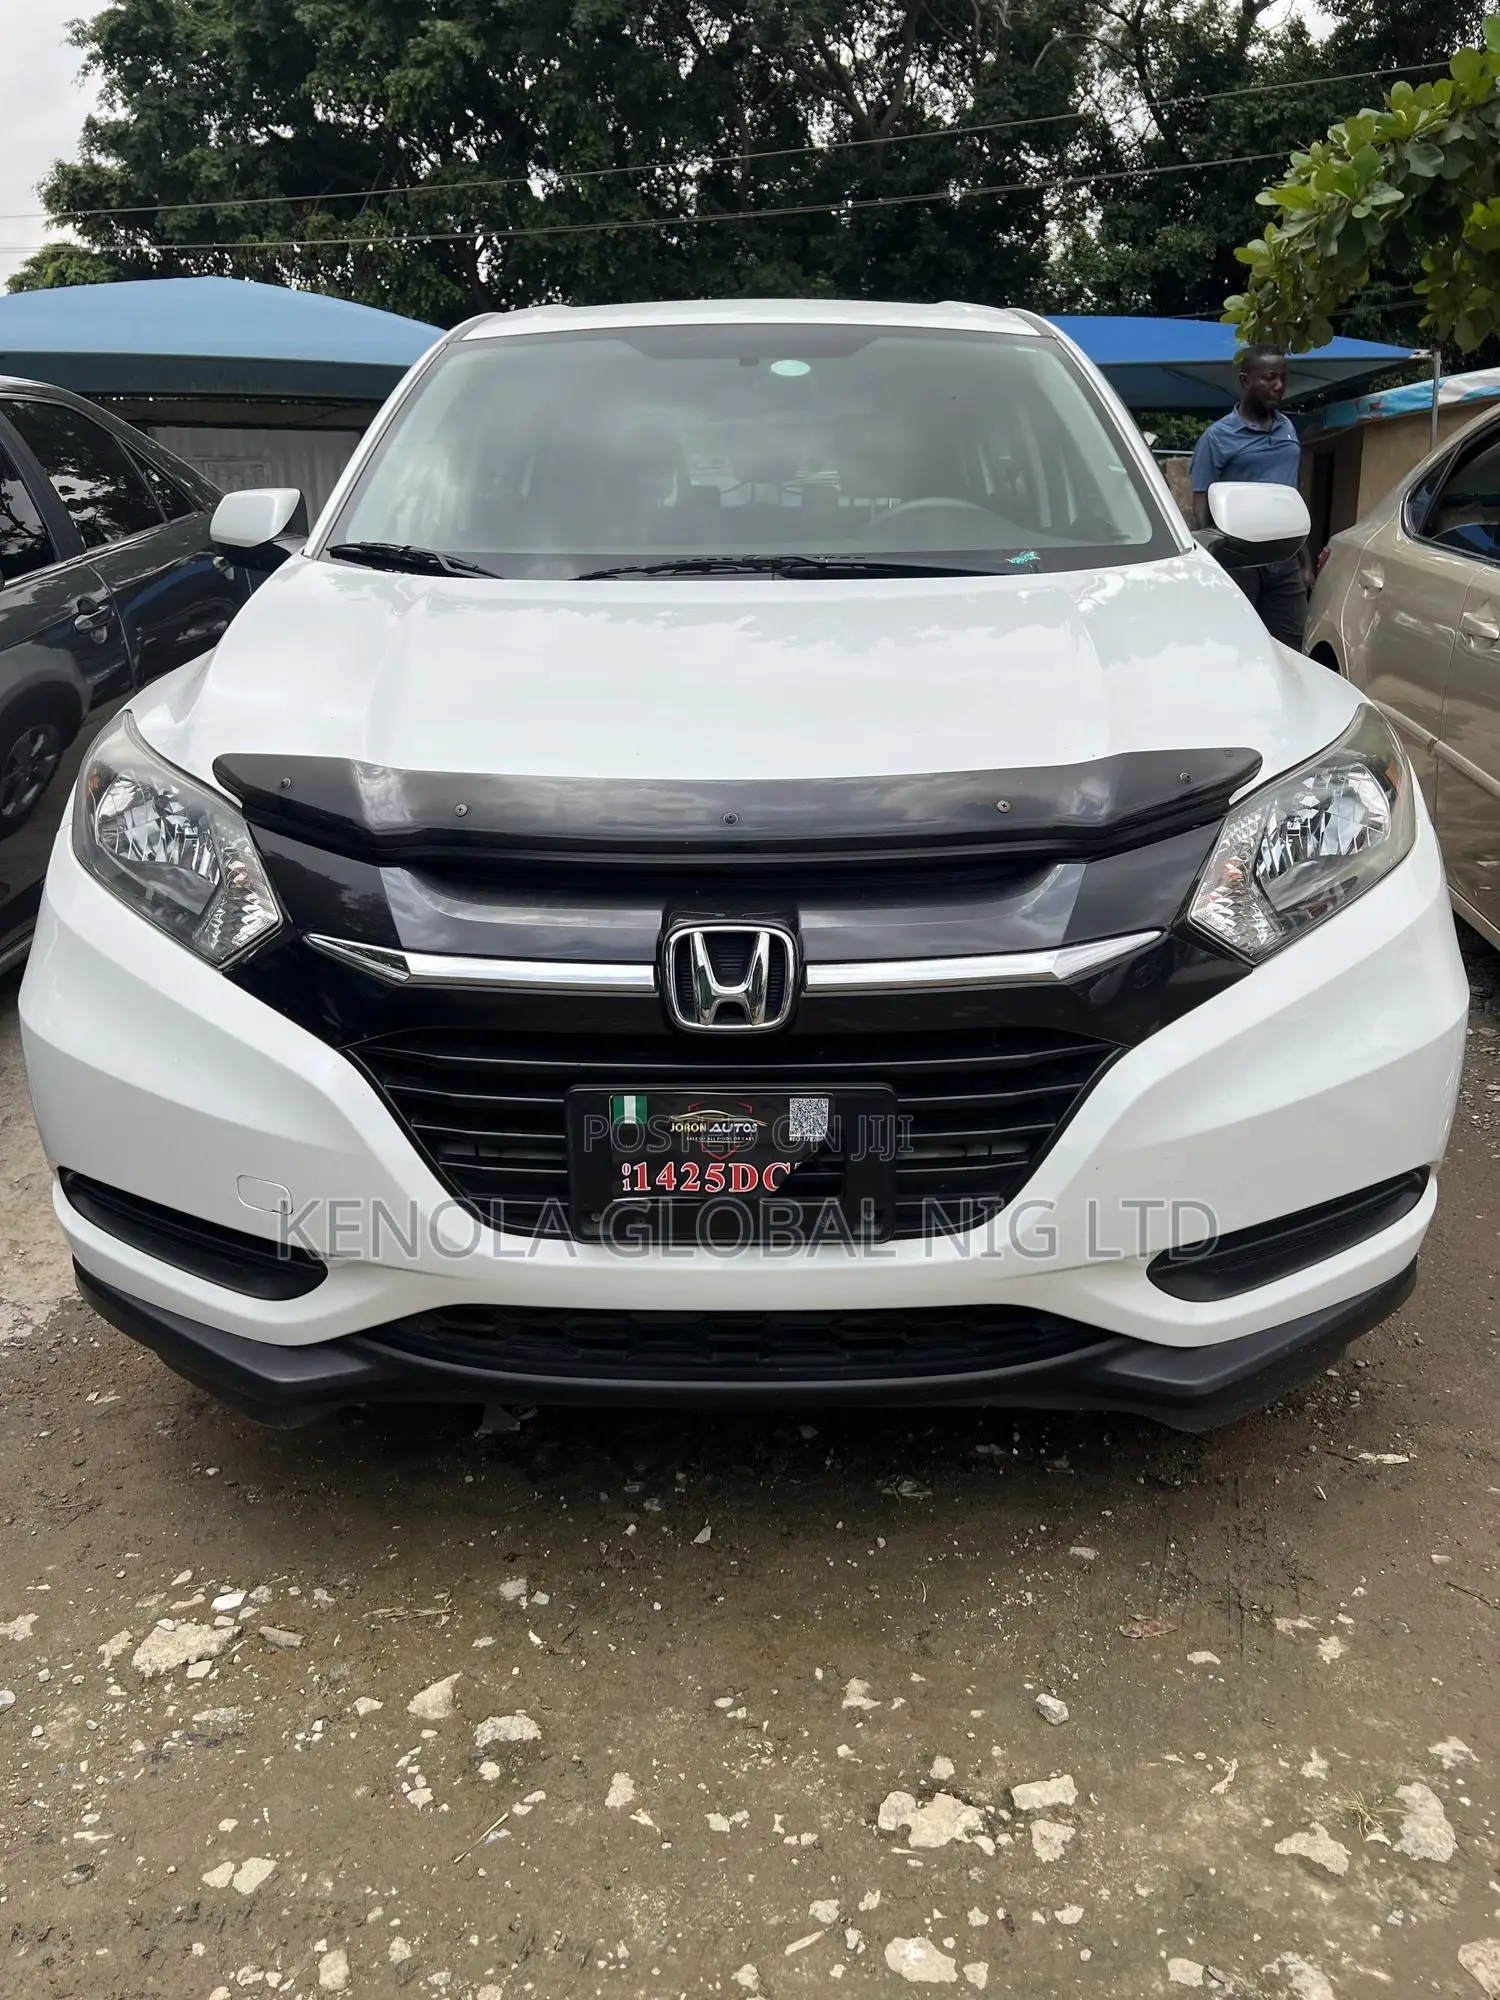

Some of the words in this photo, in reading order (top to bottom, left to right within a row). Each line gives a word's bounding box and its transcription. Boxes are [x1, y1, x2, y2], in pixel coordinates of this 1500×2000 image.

[670, 1122, 707, 1132] JORON
[709, 1123, 758, 1133] AUTOS
[633, 1161, 802, 1193] 1425DC
